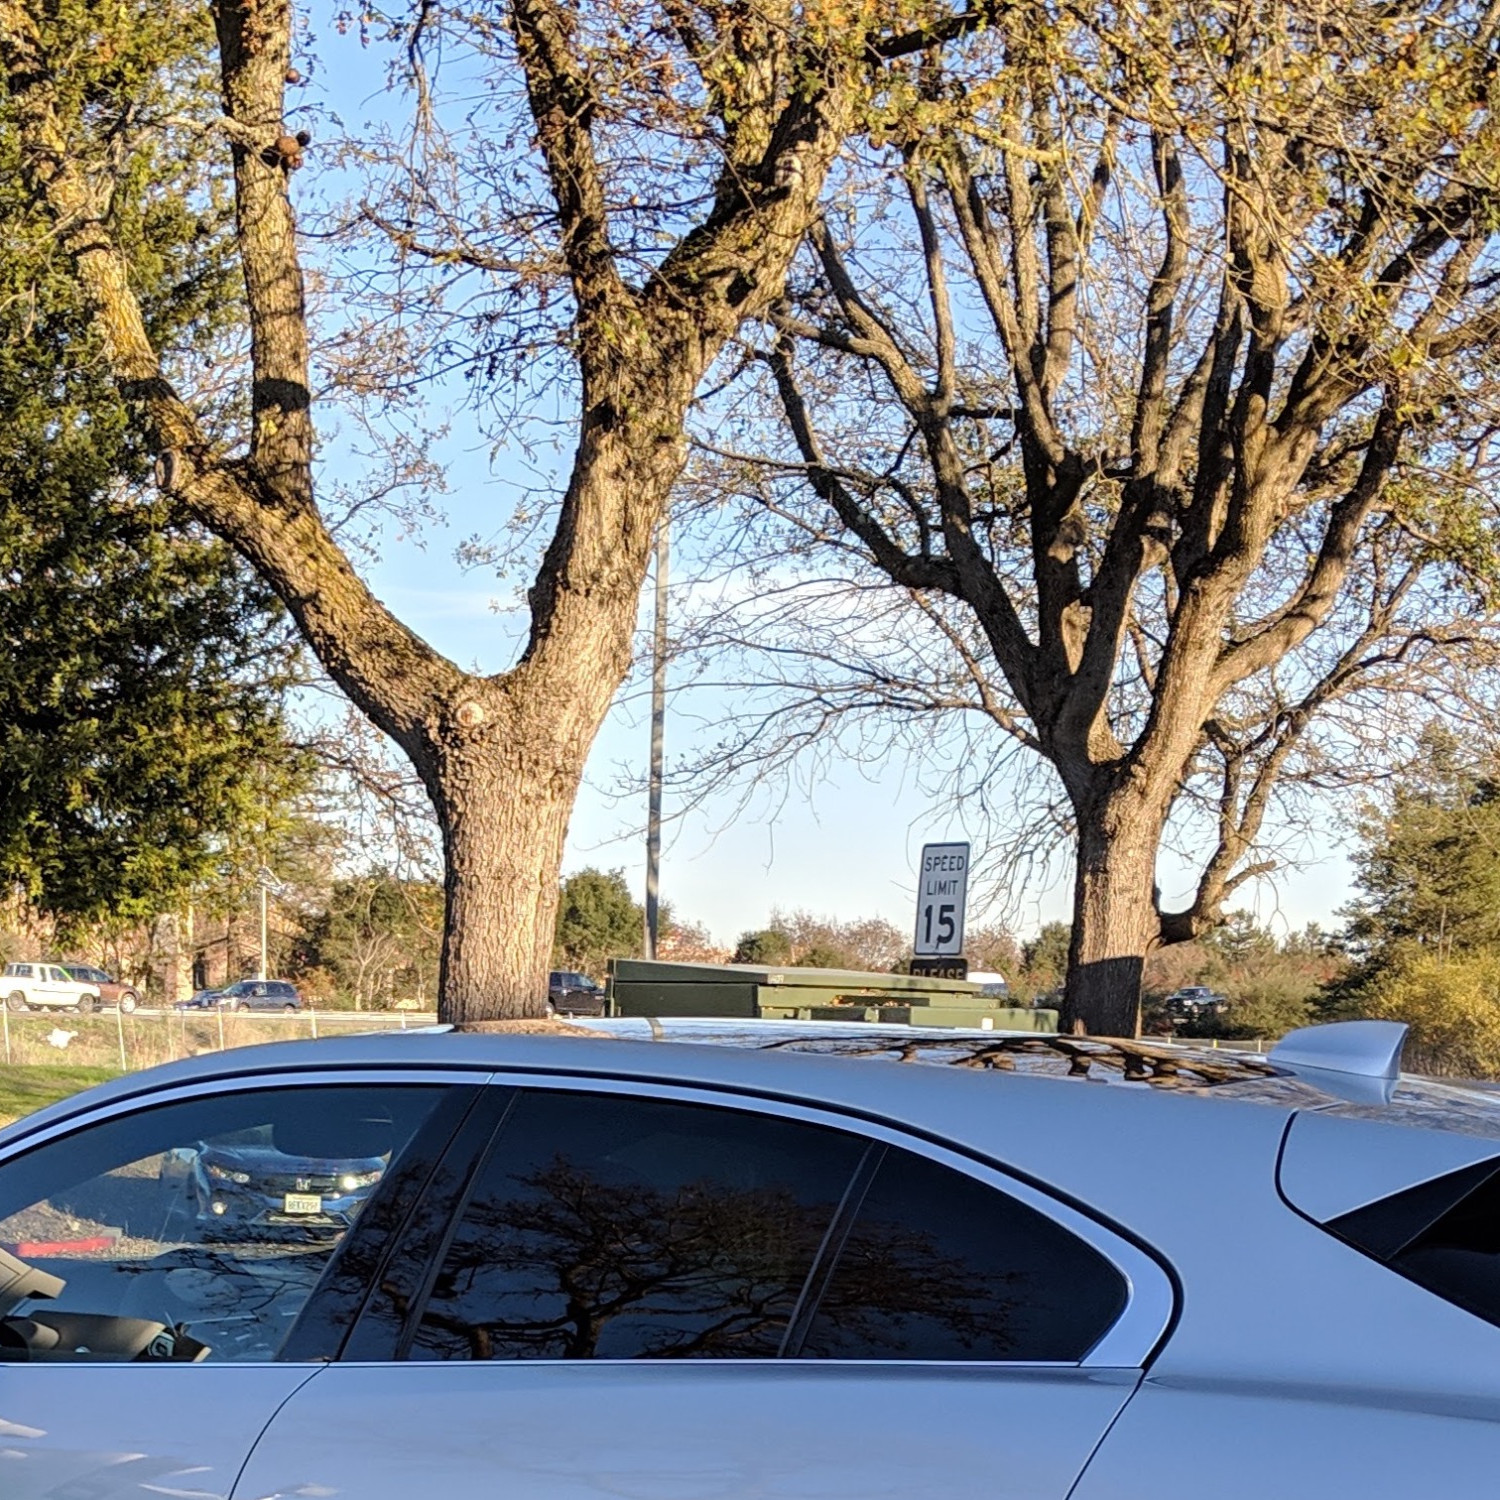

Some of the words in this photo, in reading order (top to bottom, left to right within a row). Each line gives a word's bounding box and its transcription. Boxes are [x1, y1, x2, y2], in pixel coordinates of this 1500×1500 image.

[924, 855, 965, 872] SPEED
[926, 879, 959, 896] LIMIT
[924, 904, 956, 944] 15
